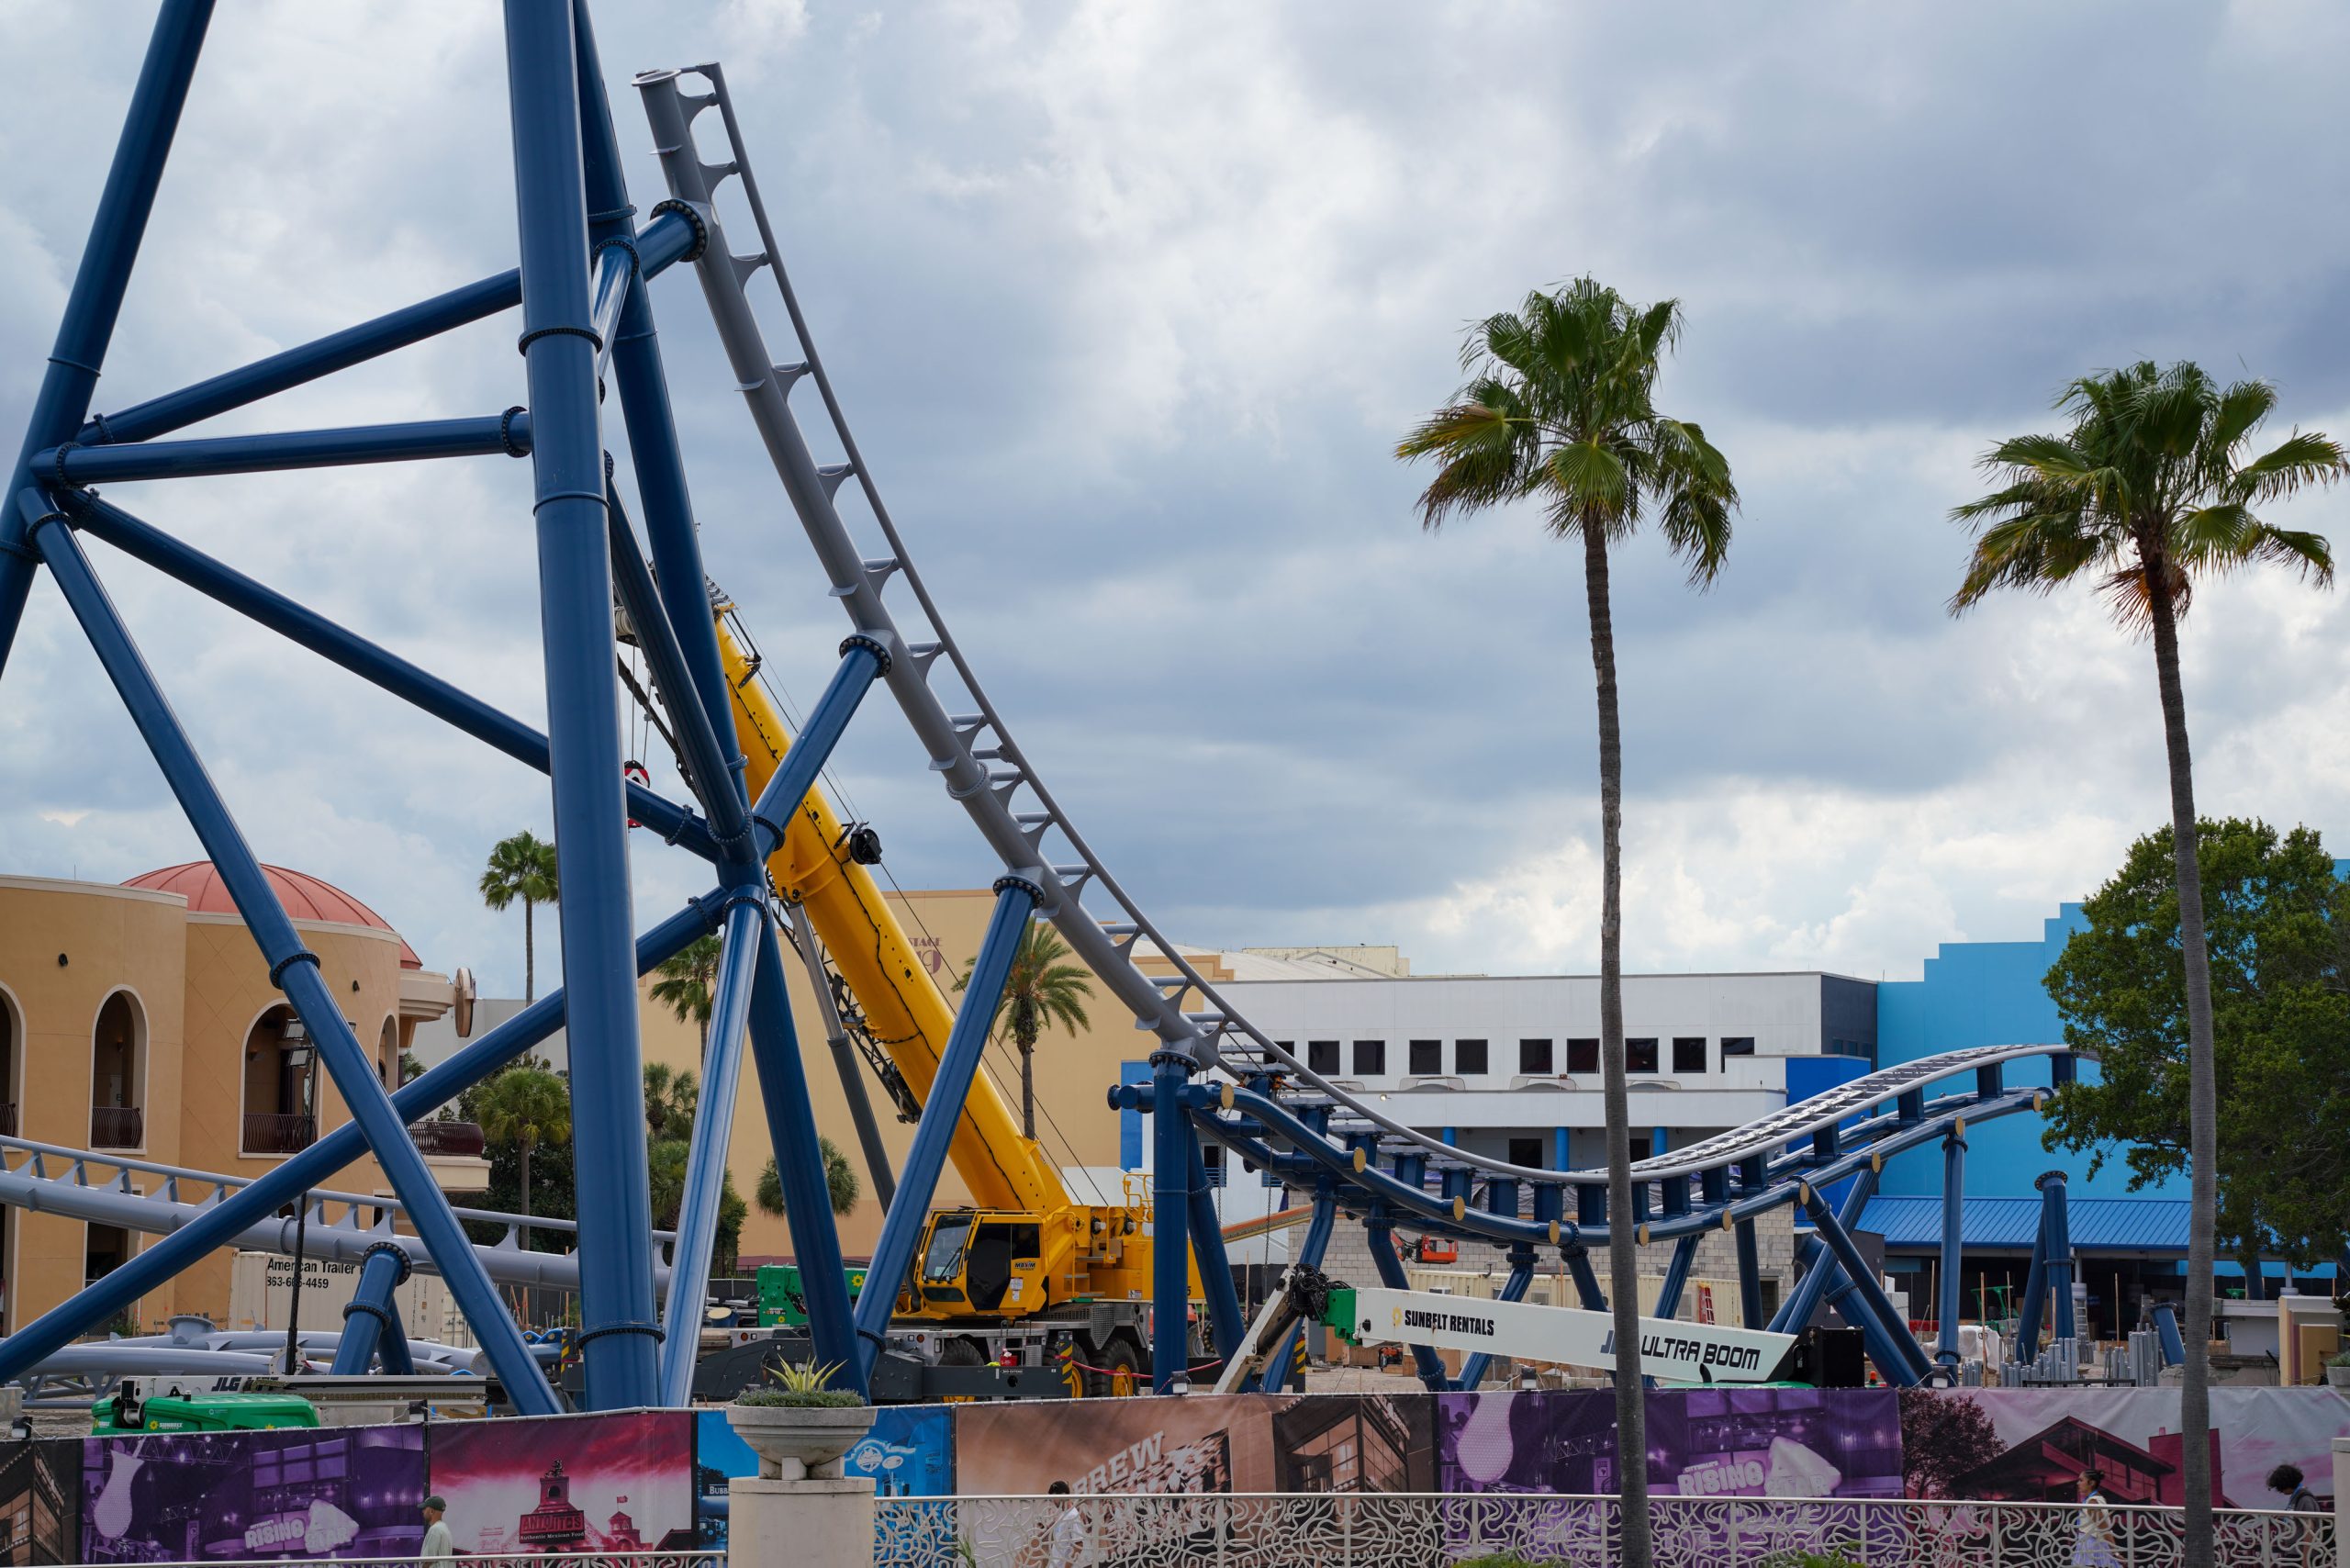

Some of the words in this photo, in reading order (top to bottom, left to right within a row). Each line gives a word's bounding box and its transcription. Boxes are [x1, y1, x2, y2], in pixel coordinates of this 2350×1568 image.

[916, 949, 942, 974] 9
[267, 1258, 317, 1272] Amercan
[321, 1260, 356, 1275] Trailer
[1404, 1309, 1448, 1330] SUNBELT
[1450, 1315, 1494, 1337] RENTALS
[1640, 1335, 1701, 1362] ULTRA
[1703, 1343, 1761, 1371] BOOM
[211, 1377, 242, 1392] JLG
[1071, 1430, 1166, 1502] BREW
